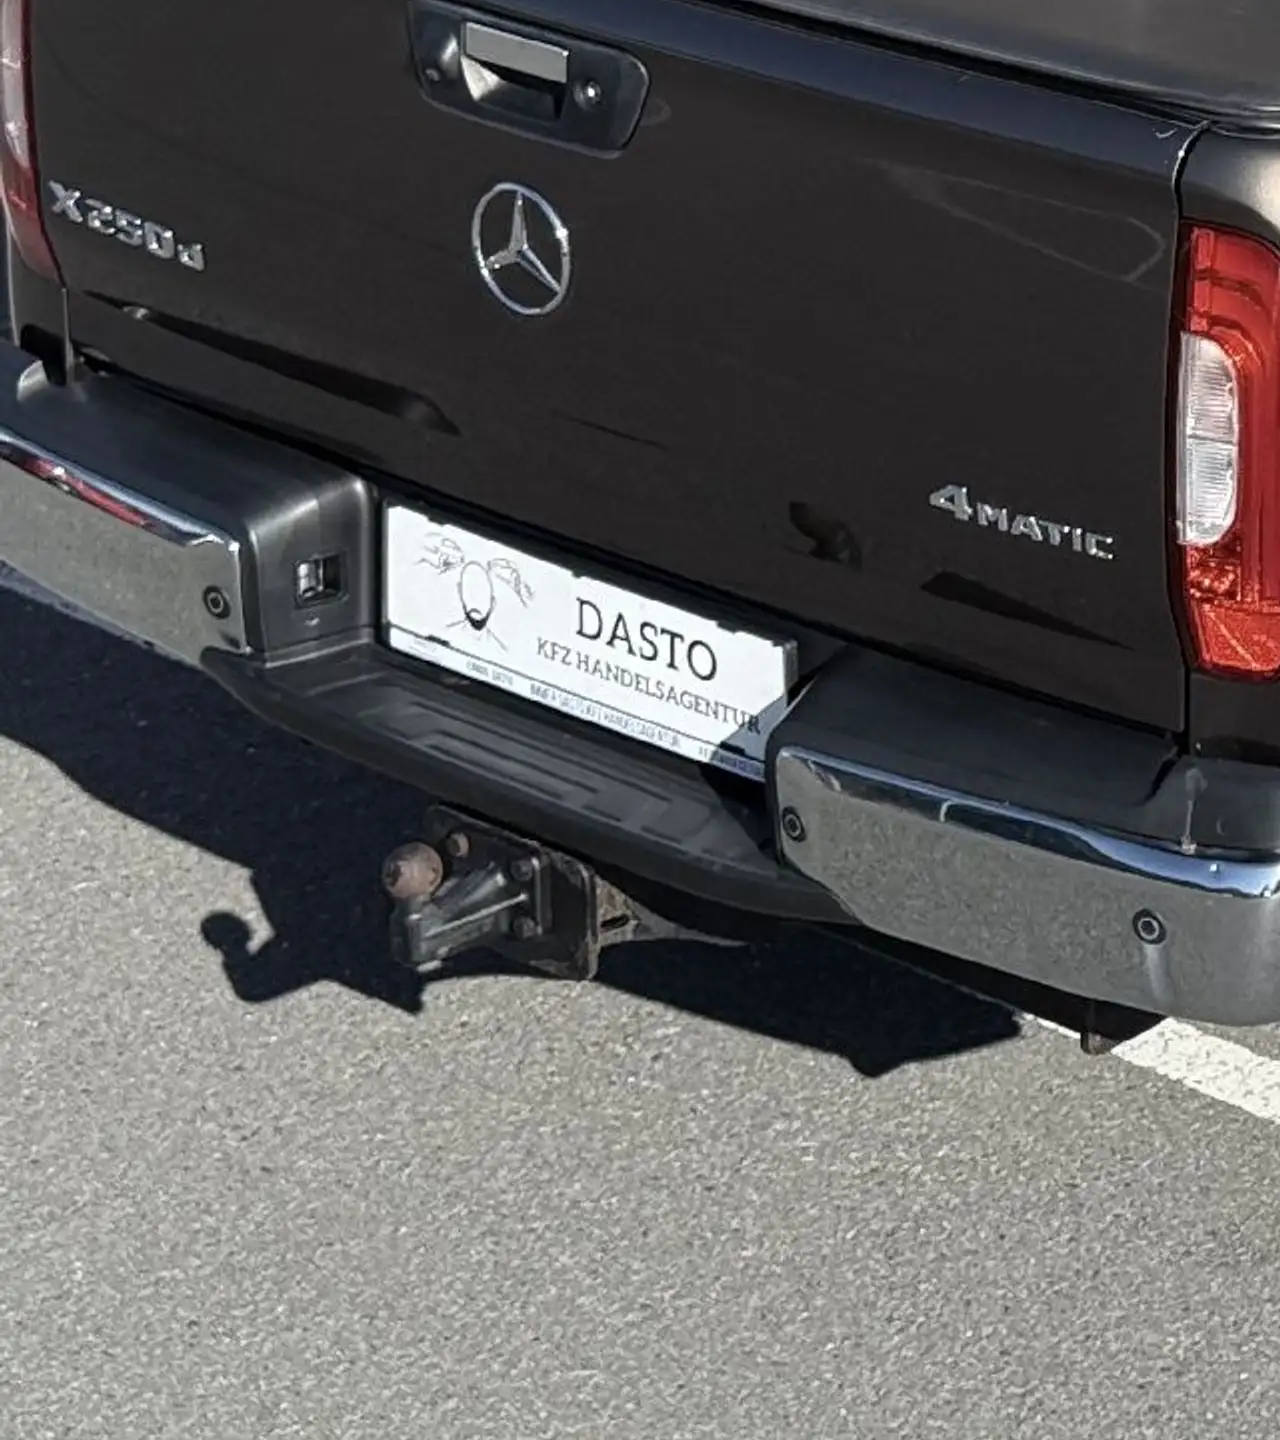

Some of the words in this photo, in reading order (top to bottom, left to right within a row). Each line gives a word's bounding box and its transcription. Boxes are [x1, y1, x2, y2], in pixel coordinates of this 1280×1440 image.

[929, 484, 1114, 560] 4MATIC
[575, 596, 719, 682] DASTO
[536, 636, 573, 668] KFZ
[574, 650, 761, 736] HANDELSAGENTUR
